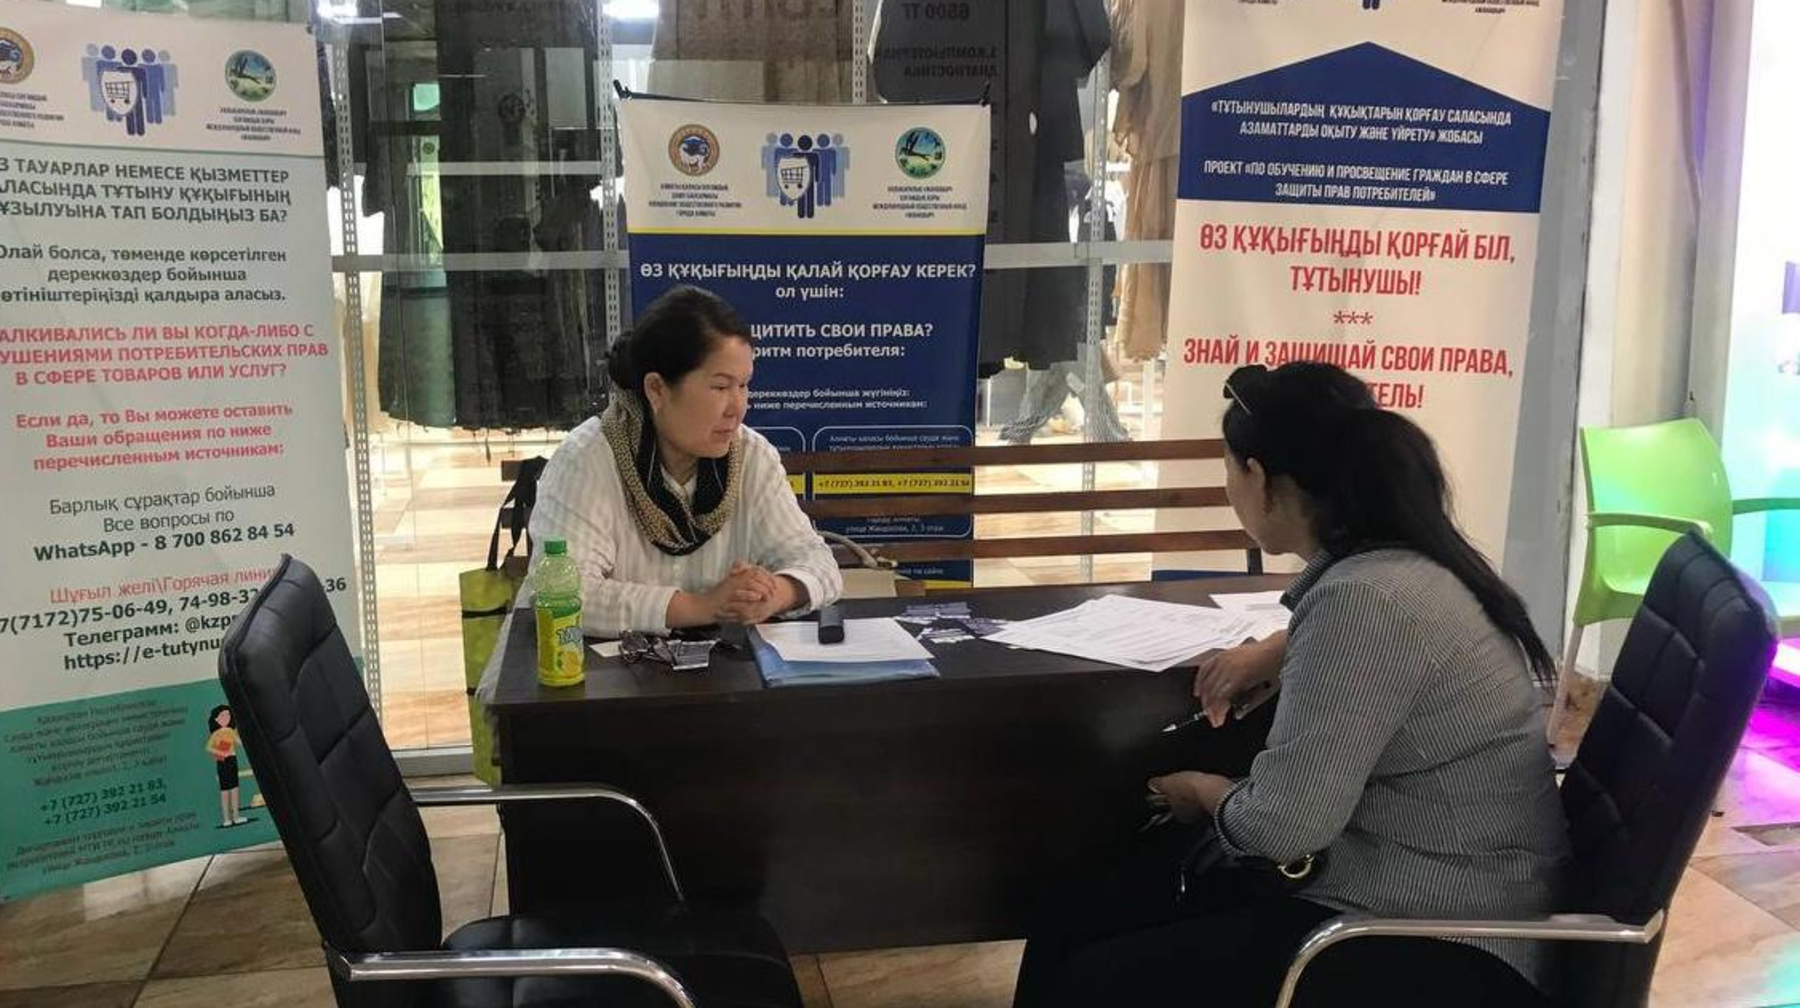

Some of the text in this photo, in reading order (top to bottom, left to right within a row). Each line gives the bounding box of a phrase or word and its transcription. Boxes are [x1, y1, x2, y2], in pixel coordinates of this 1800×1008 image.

[1404, 108, 1445, 123] ҚОРҒАУ
[1447, 109, 1512, 126] САЛАСЫНДА
[1240, 121, 1318, 138] АЗАМАТТАРДЫ
[1320, 125, 1357, 139] ОҚЫТУ
[1359, 126, 1388, 140] ЖӘНЕ
[1437, 129, 1483, 144] ЖОБАСЫ
[14, 158, 110, 178] ТАУАРЛАР
[115, 163, 185, 181] НЕМЕСЕ
[190, 167, 289, 184] ҚЫЗМЕТТЕР
[1204, 160, 1508, 186] ПРОЕКТ «ПО ОБУЧЕНИЮ И ПРОСВЕЩЕНИЕ ГРАЖДАН В СФЕРЕ
[101, 184, 174, 202] ТҰТЫНУ
[1275, 182, 1436, 202] ЗАЩИТЫ ПРАВ ПОТРЕБИТЕЛЕЙ»
[110, 205, 146, 219] ТАП
[152, 205, 255, 224] БОЛДЫҢЫЗ
[260, 208, 287, 222] БА?
[49, 245, 106, 262] болса,
[112, 249, 186, 263] төменде
[190, 247, 287, 265] көрсетілген
[1200, 224, 1515, 264] ӨЗ ҚҰҚЫҒЫҢДЫ ҚОРҒАЙ БІЛ,
[48, 265, 247, 284] дереккөздер бойынша
[641, 263, 662, 278] ӨЗ
[786, 260, 843, 280] ҚАЛАЙ
[849, 263, 910, 281] ҚОРҒАУ
[917, 263, 976, 279] КЕРЕК?
[1291, 265, 1421, 295] ТҰТЫНУШЫ!
[144, 288, 220, 304] қалдыра
[225, 288, 286, 302] аласыз.
[776, 282, 844, 300] ол үшін:
[132, 326, 159, 341] ЛИ
[163, 325, 189, 340] ВЫ
[194, 324, 299, 341] КОГДА-ЛИБО
[304, 324, 314, 337] С
[820, 324, 866, 338] СВОИ
[871, 323, 933, 338] ПРАВА?
[119, 345, 282, 361] ПОТРЕБИТЕЛЬСКИХ
[287, 343, 328, 358] ПРАВ
[752, 344, 905, 360] ритм потребителя:
[1184, 334, 1238, 364] ЗНАЙ
[1246, 341, 1259, 364] И
[1381, 345, 1434, 371] СВОИ
[1439, 348, 1513, 377] ПРАВА,
[15, 363, 287, 386] В СФЕРЕ ТОВАРОВ ИЛИ УСЛУГ?
[813, 387, 860, 398] бойынша
[1366, 382, 1423, 409] ТЕЛЬ!
[16, 403, 294, 429] Если да, то Вы можете оставить
[754, 401, 781, 410] ниже
[783, 401, 863, 411] перечисленным
[45, 424, 271, 449] Ваши обращения по ниже
[33, 443, 285, 472] перечисленным источникам:
[49, 484, 276, 516] Барлық сұрақтар бойынша
[103, 510, 235, 533] Все вопросы по
[34, 539, 136, 562] WhatsApp
[154, 535, 167, 552] 8
[172, 532, 206, 549] 700
[210, 528, 243, 545] 862
[247, 525, 269, 541] 84
[273, 522, 295, 539] 54
[50, 584, 112, 605] Шұғыл
[234, 566, 276, 584] лини
[64, 621, 180, 648] Телеграмм:
[64, 638, 225, 671] https://e-tutynu
